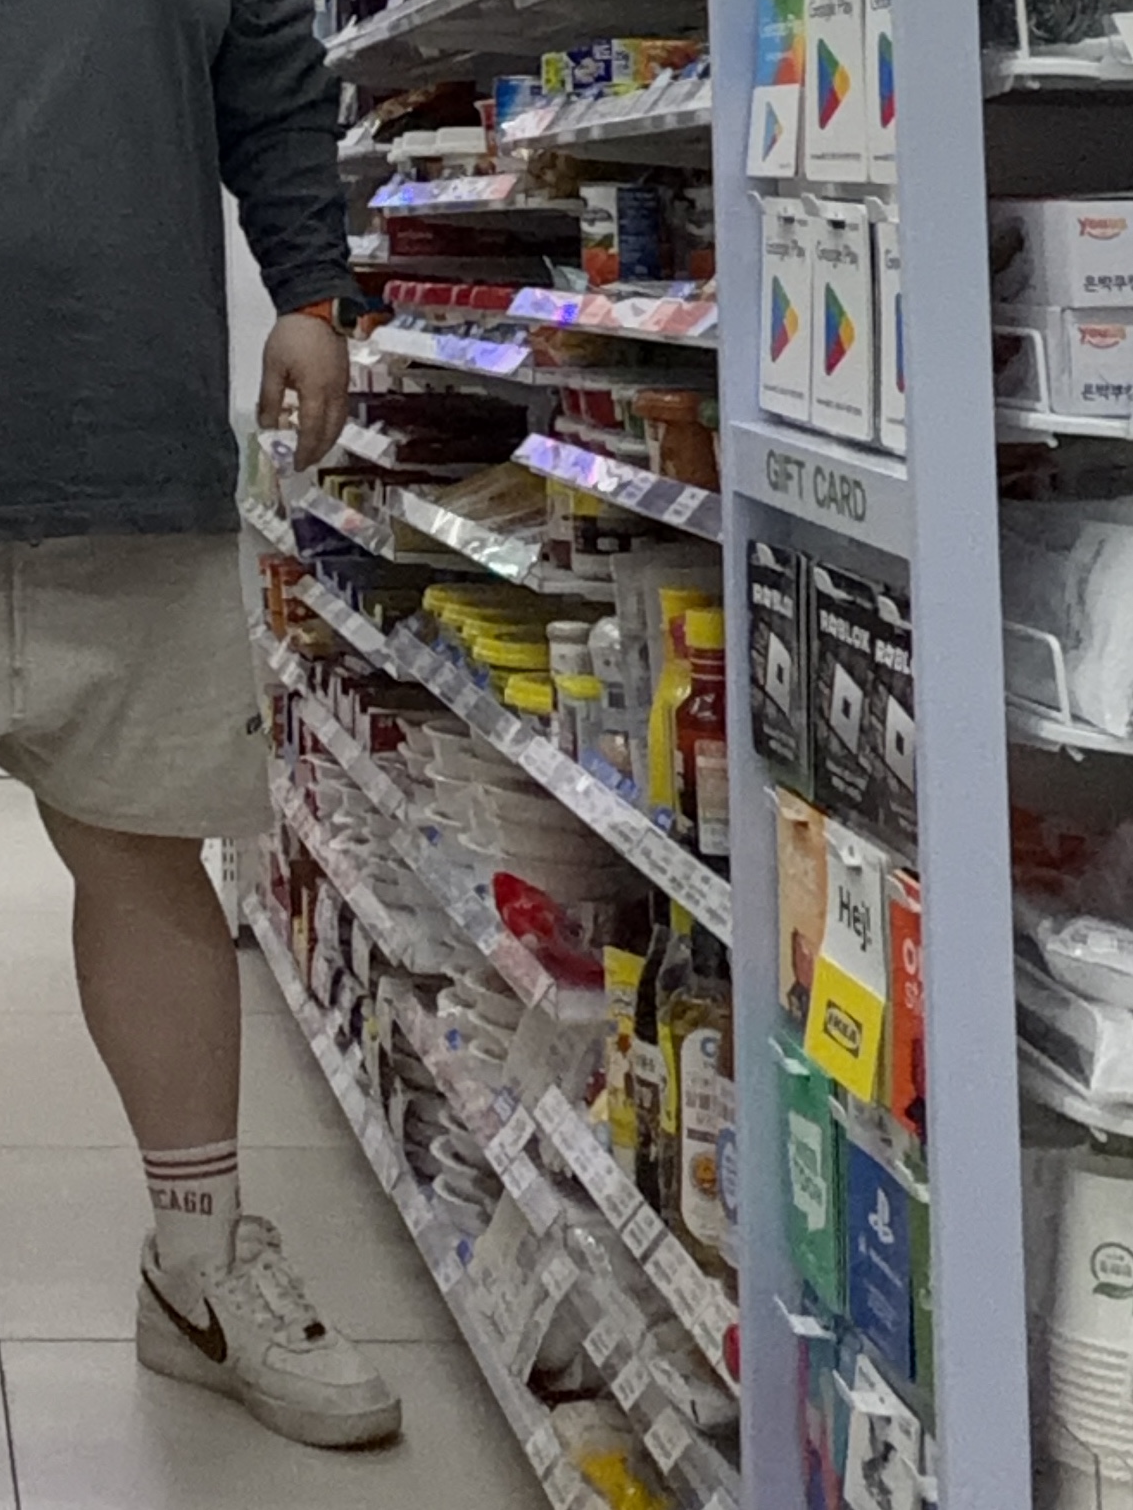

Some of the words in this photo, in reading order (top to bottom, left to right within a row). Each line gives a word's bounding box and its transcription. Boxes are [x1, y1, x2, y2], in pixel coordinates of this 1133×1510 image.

[766, 448, 806, 501] GIFT
[813, 464, 867, 522] CARD
[875, 638, 911, 675] ROBL
